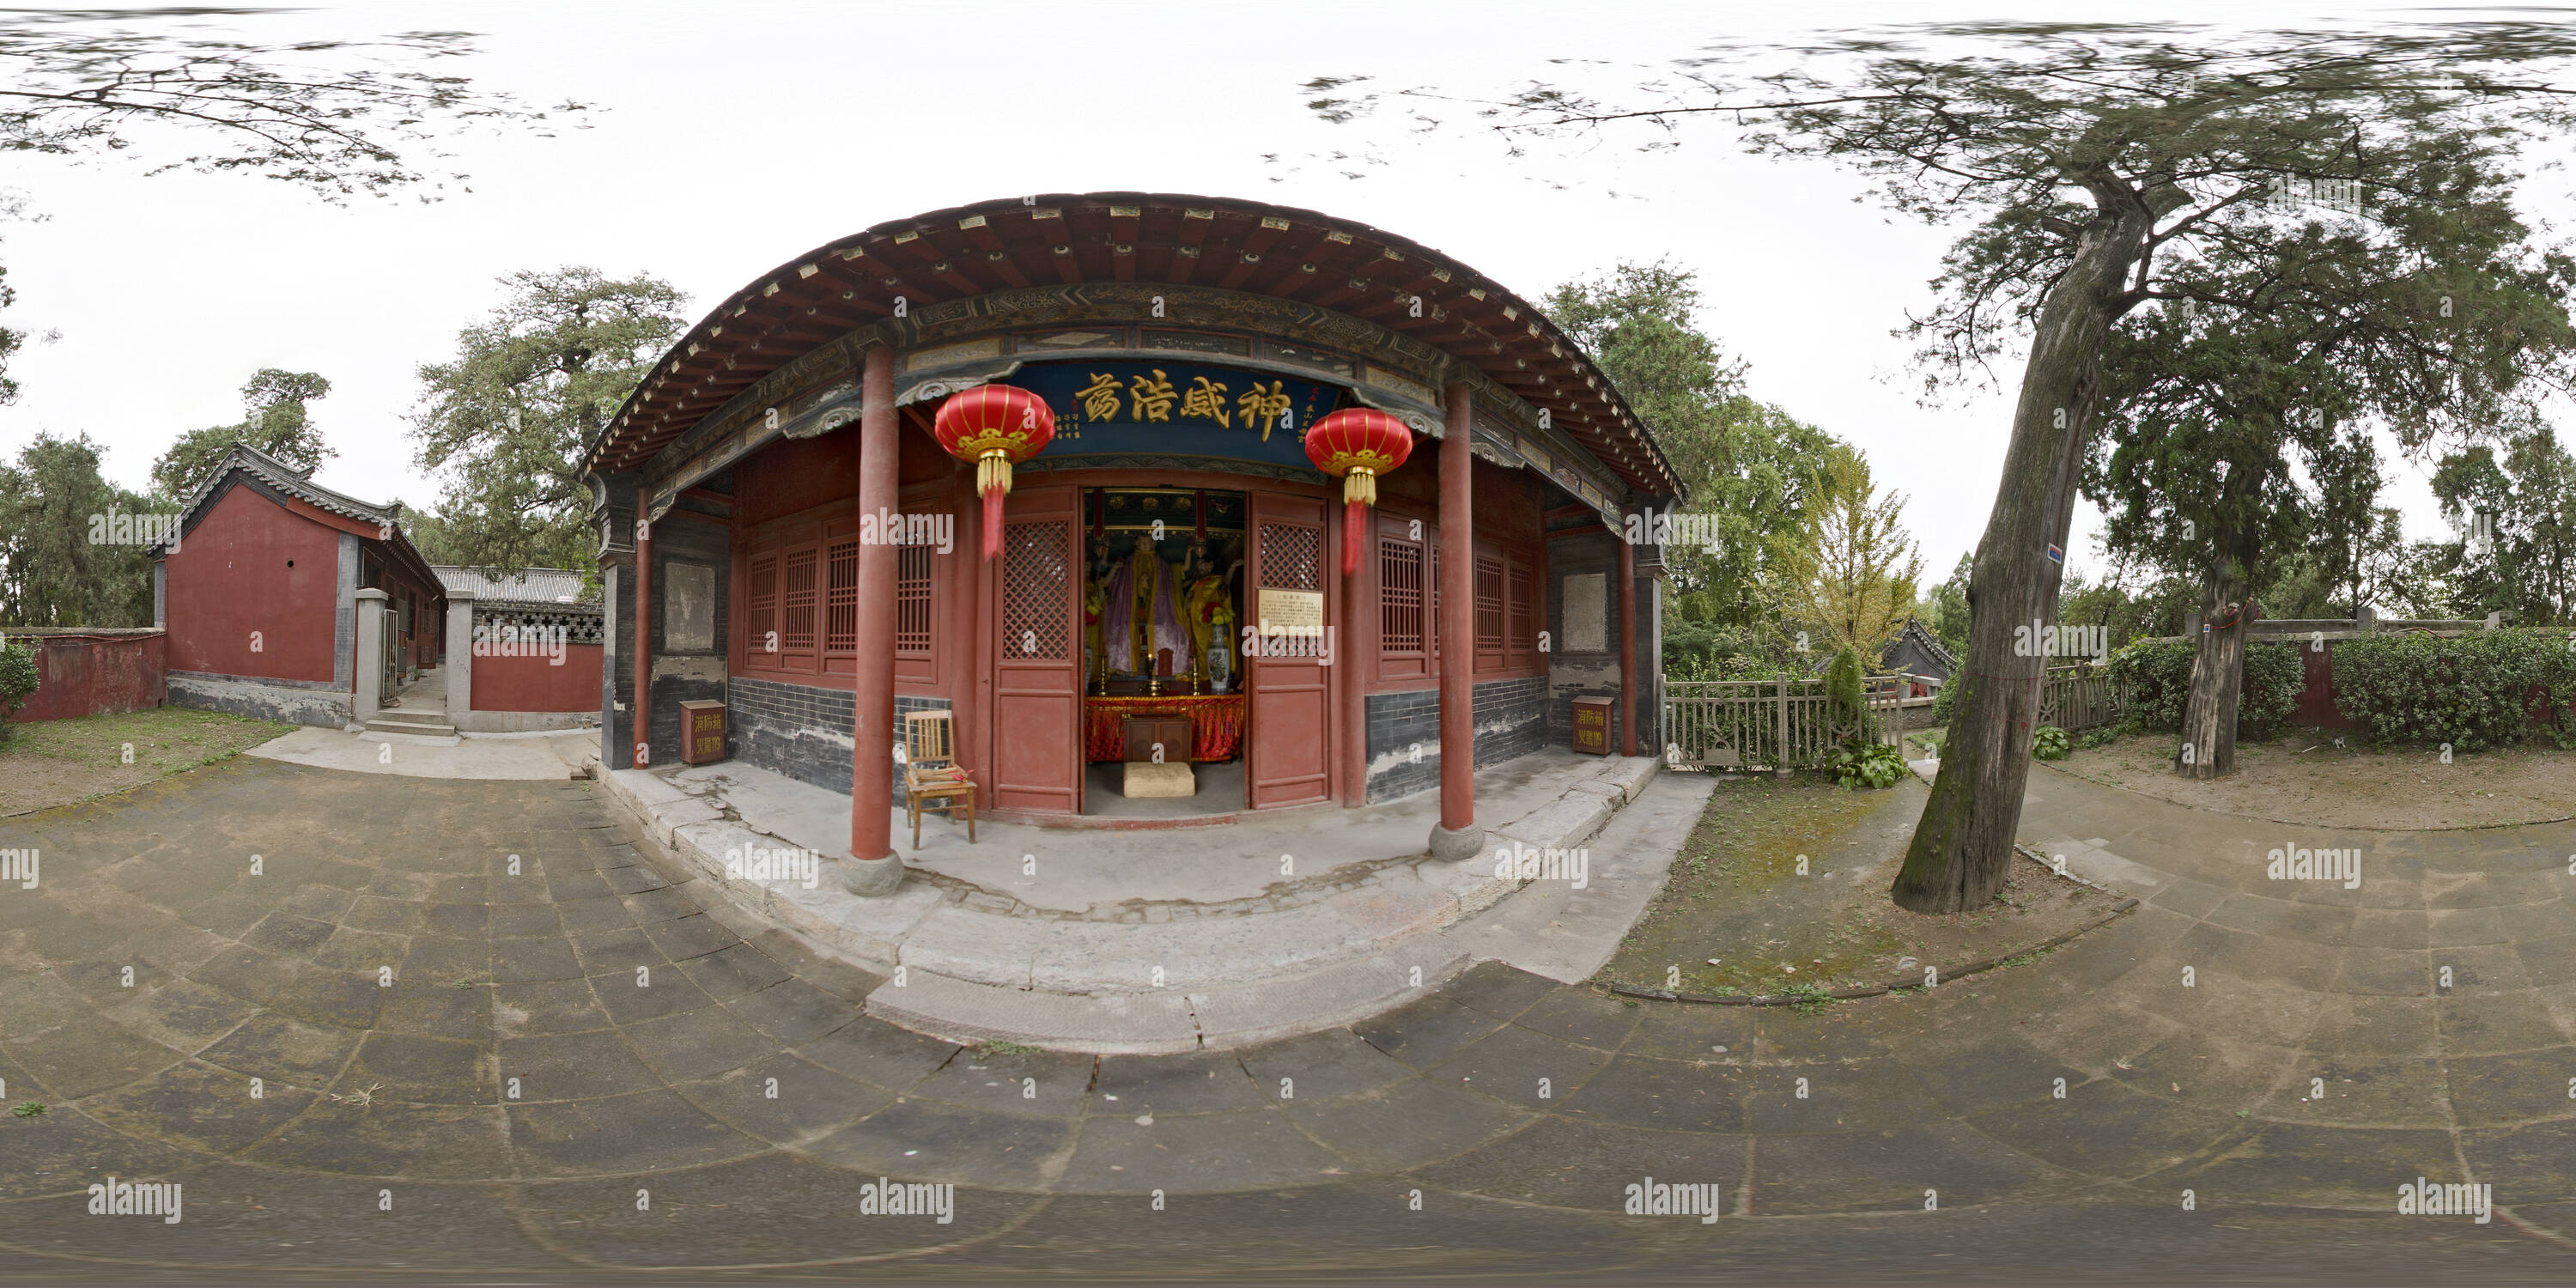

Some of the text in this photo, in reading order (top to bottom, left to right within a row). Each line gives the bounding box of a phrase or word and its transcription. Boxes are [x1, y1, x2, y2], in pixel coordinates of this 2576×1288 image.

[695, 714, 721, 732] 消防箱
[1577, 709, 1604, 726] 消防箱
